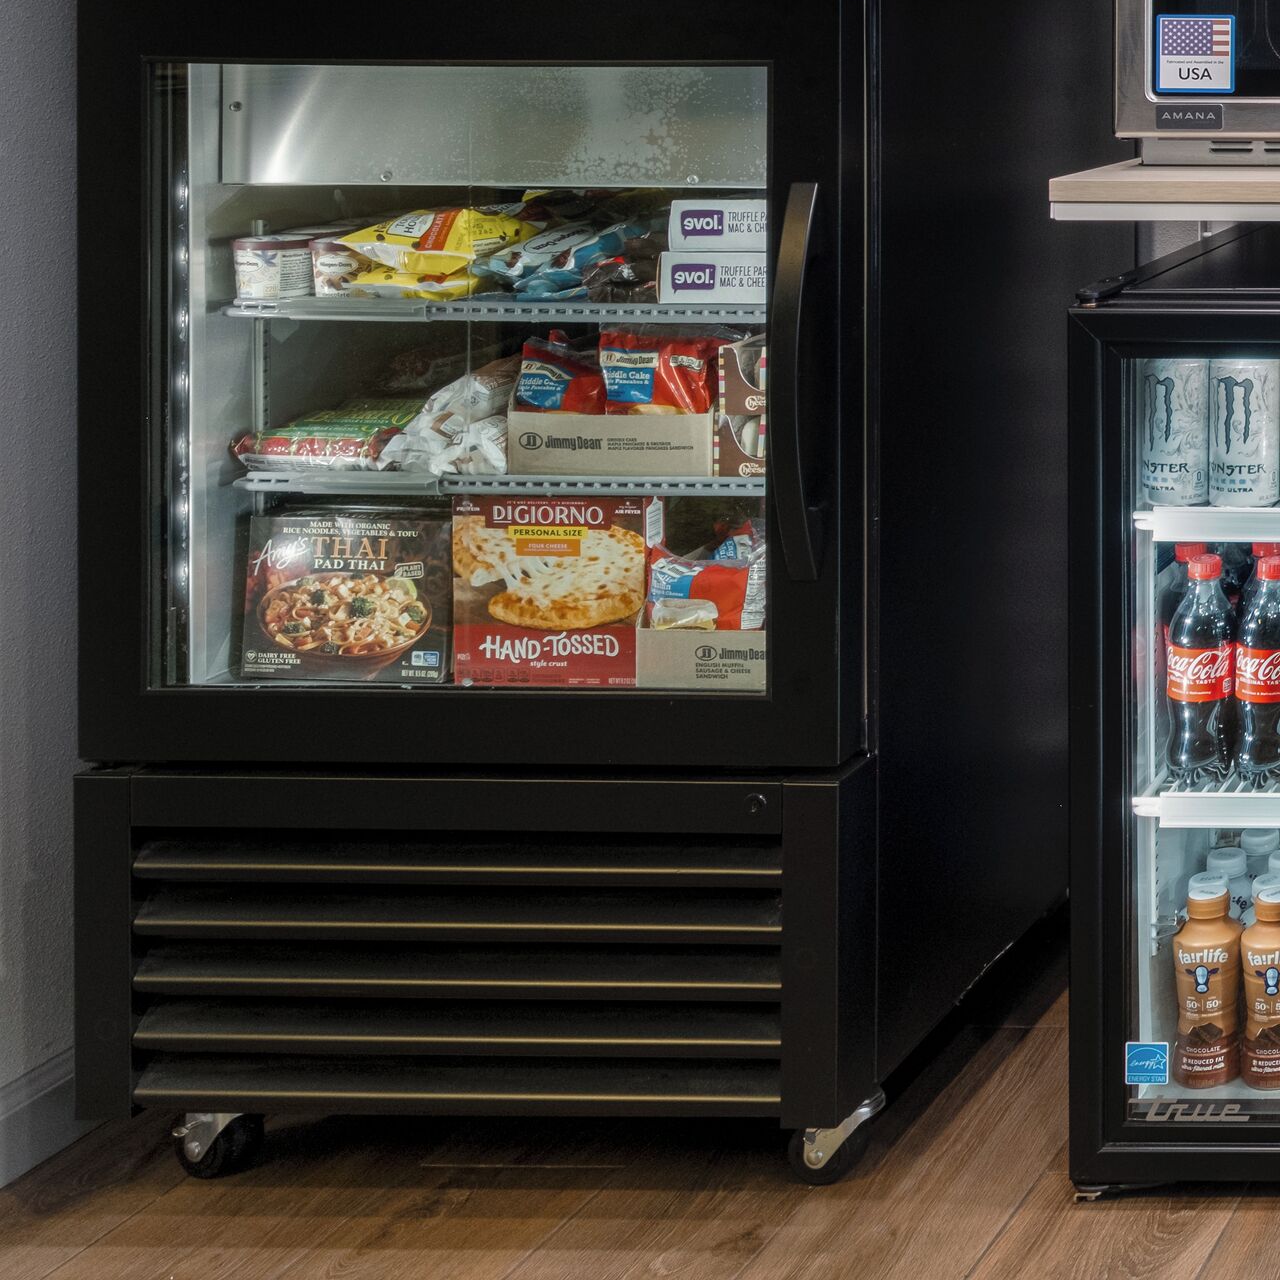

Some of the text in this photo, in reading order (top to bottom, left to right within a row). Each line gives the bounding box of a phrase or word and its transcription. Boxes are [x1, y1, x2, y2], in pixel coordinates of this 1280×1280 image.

[1178, 68, 1212, 80] USA
[1162, 112, 1215, 120] AMANA
[728, 211, 759, 221] TRUFFLE
[728, 223, 745, 233] MAC
[720, 266, 751, 276] TRUFFLE
[720, 278, 737, 287] MAC
[545, 434, 577, 451] Jimmy
[577, 437, 602, 450] Dean
[311, 536, 389, 560] THAI
[314, 559, 385, 570] PAD THAI
[1186, 1045, 1221, 1053] CHOCOLATE
